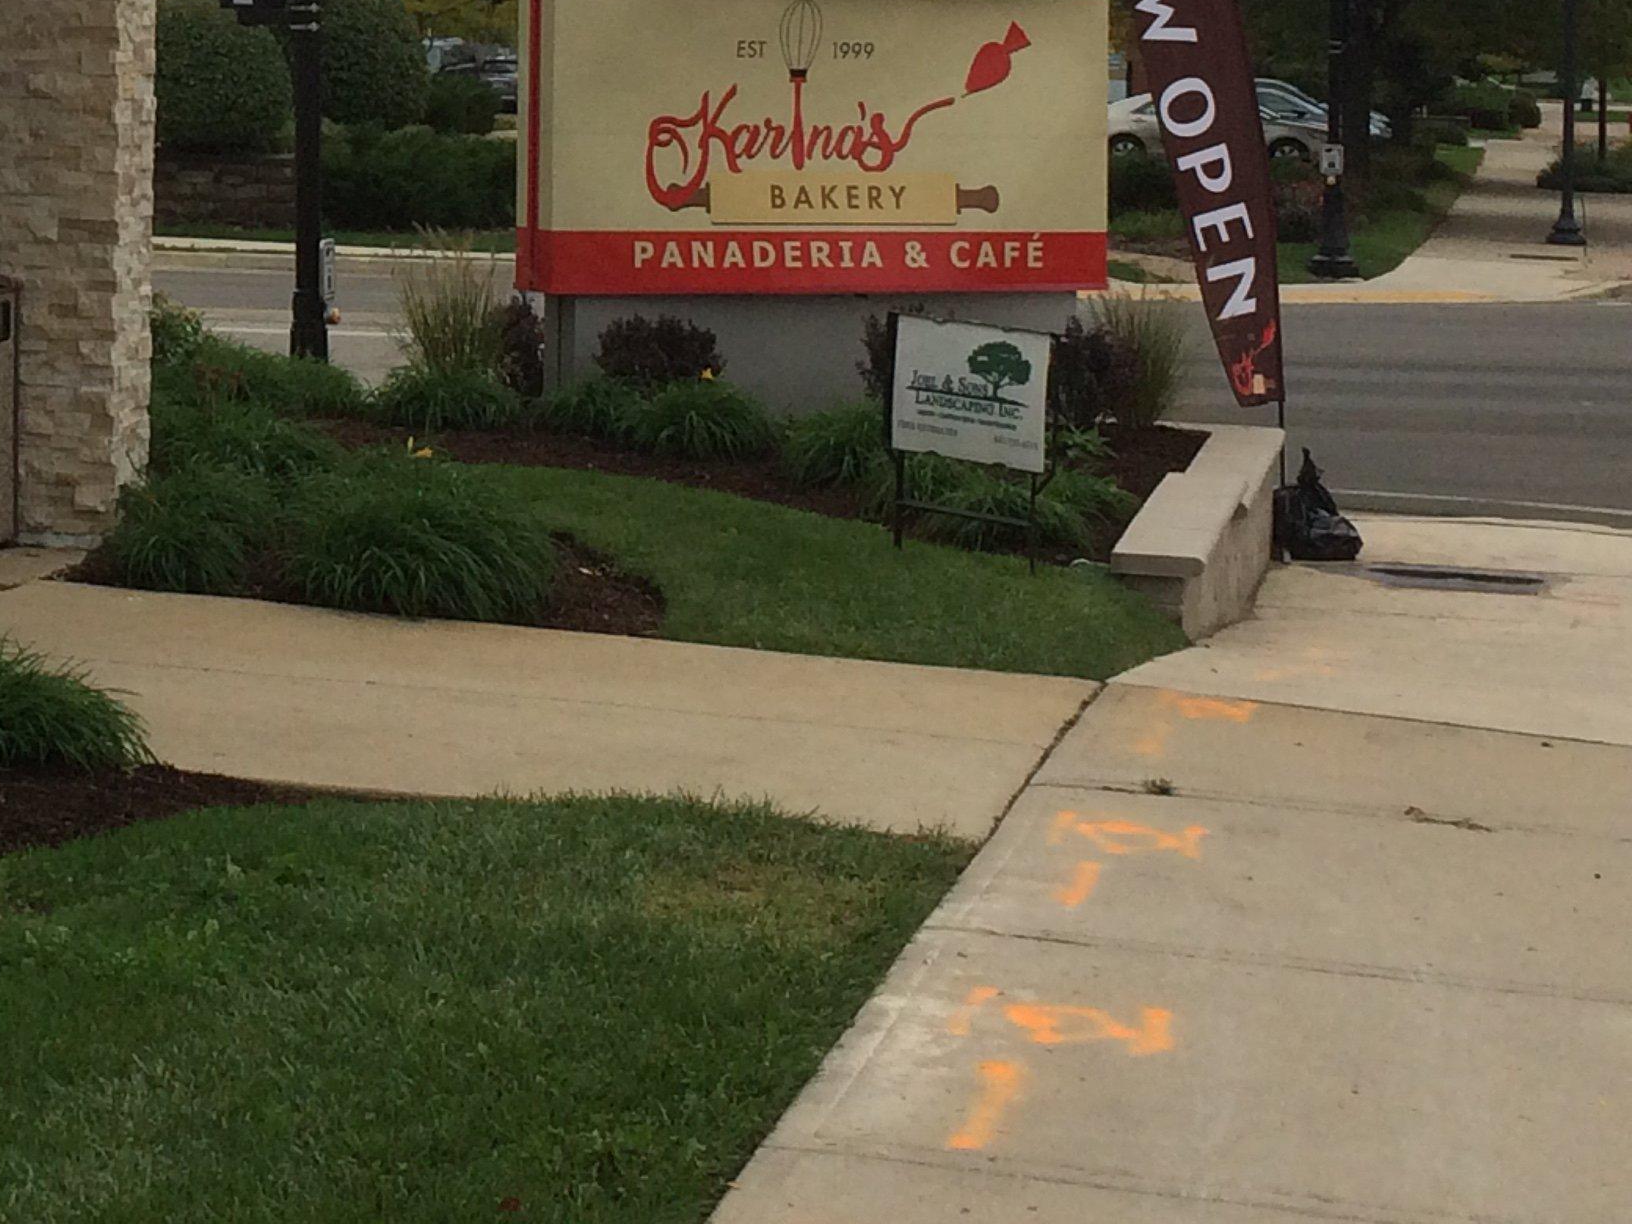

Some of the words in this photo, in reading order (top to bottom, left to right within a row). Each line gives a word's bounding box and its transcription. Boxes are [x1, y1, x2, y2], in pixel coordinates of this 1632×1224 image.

[736, 40, 767, 59] EST
[832, 41, 875, 60] 1999
[770, 184, 906, 209] BAKERY
[1160, 77, 1256, 321] OPEN
[633, 240, 884, 269] PANADERIA
[904, 241, 930, 269] &
[950, 233, 1045, 269] CAFÉ
